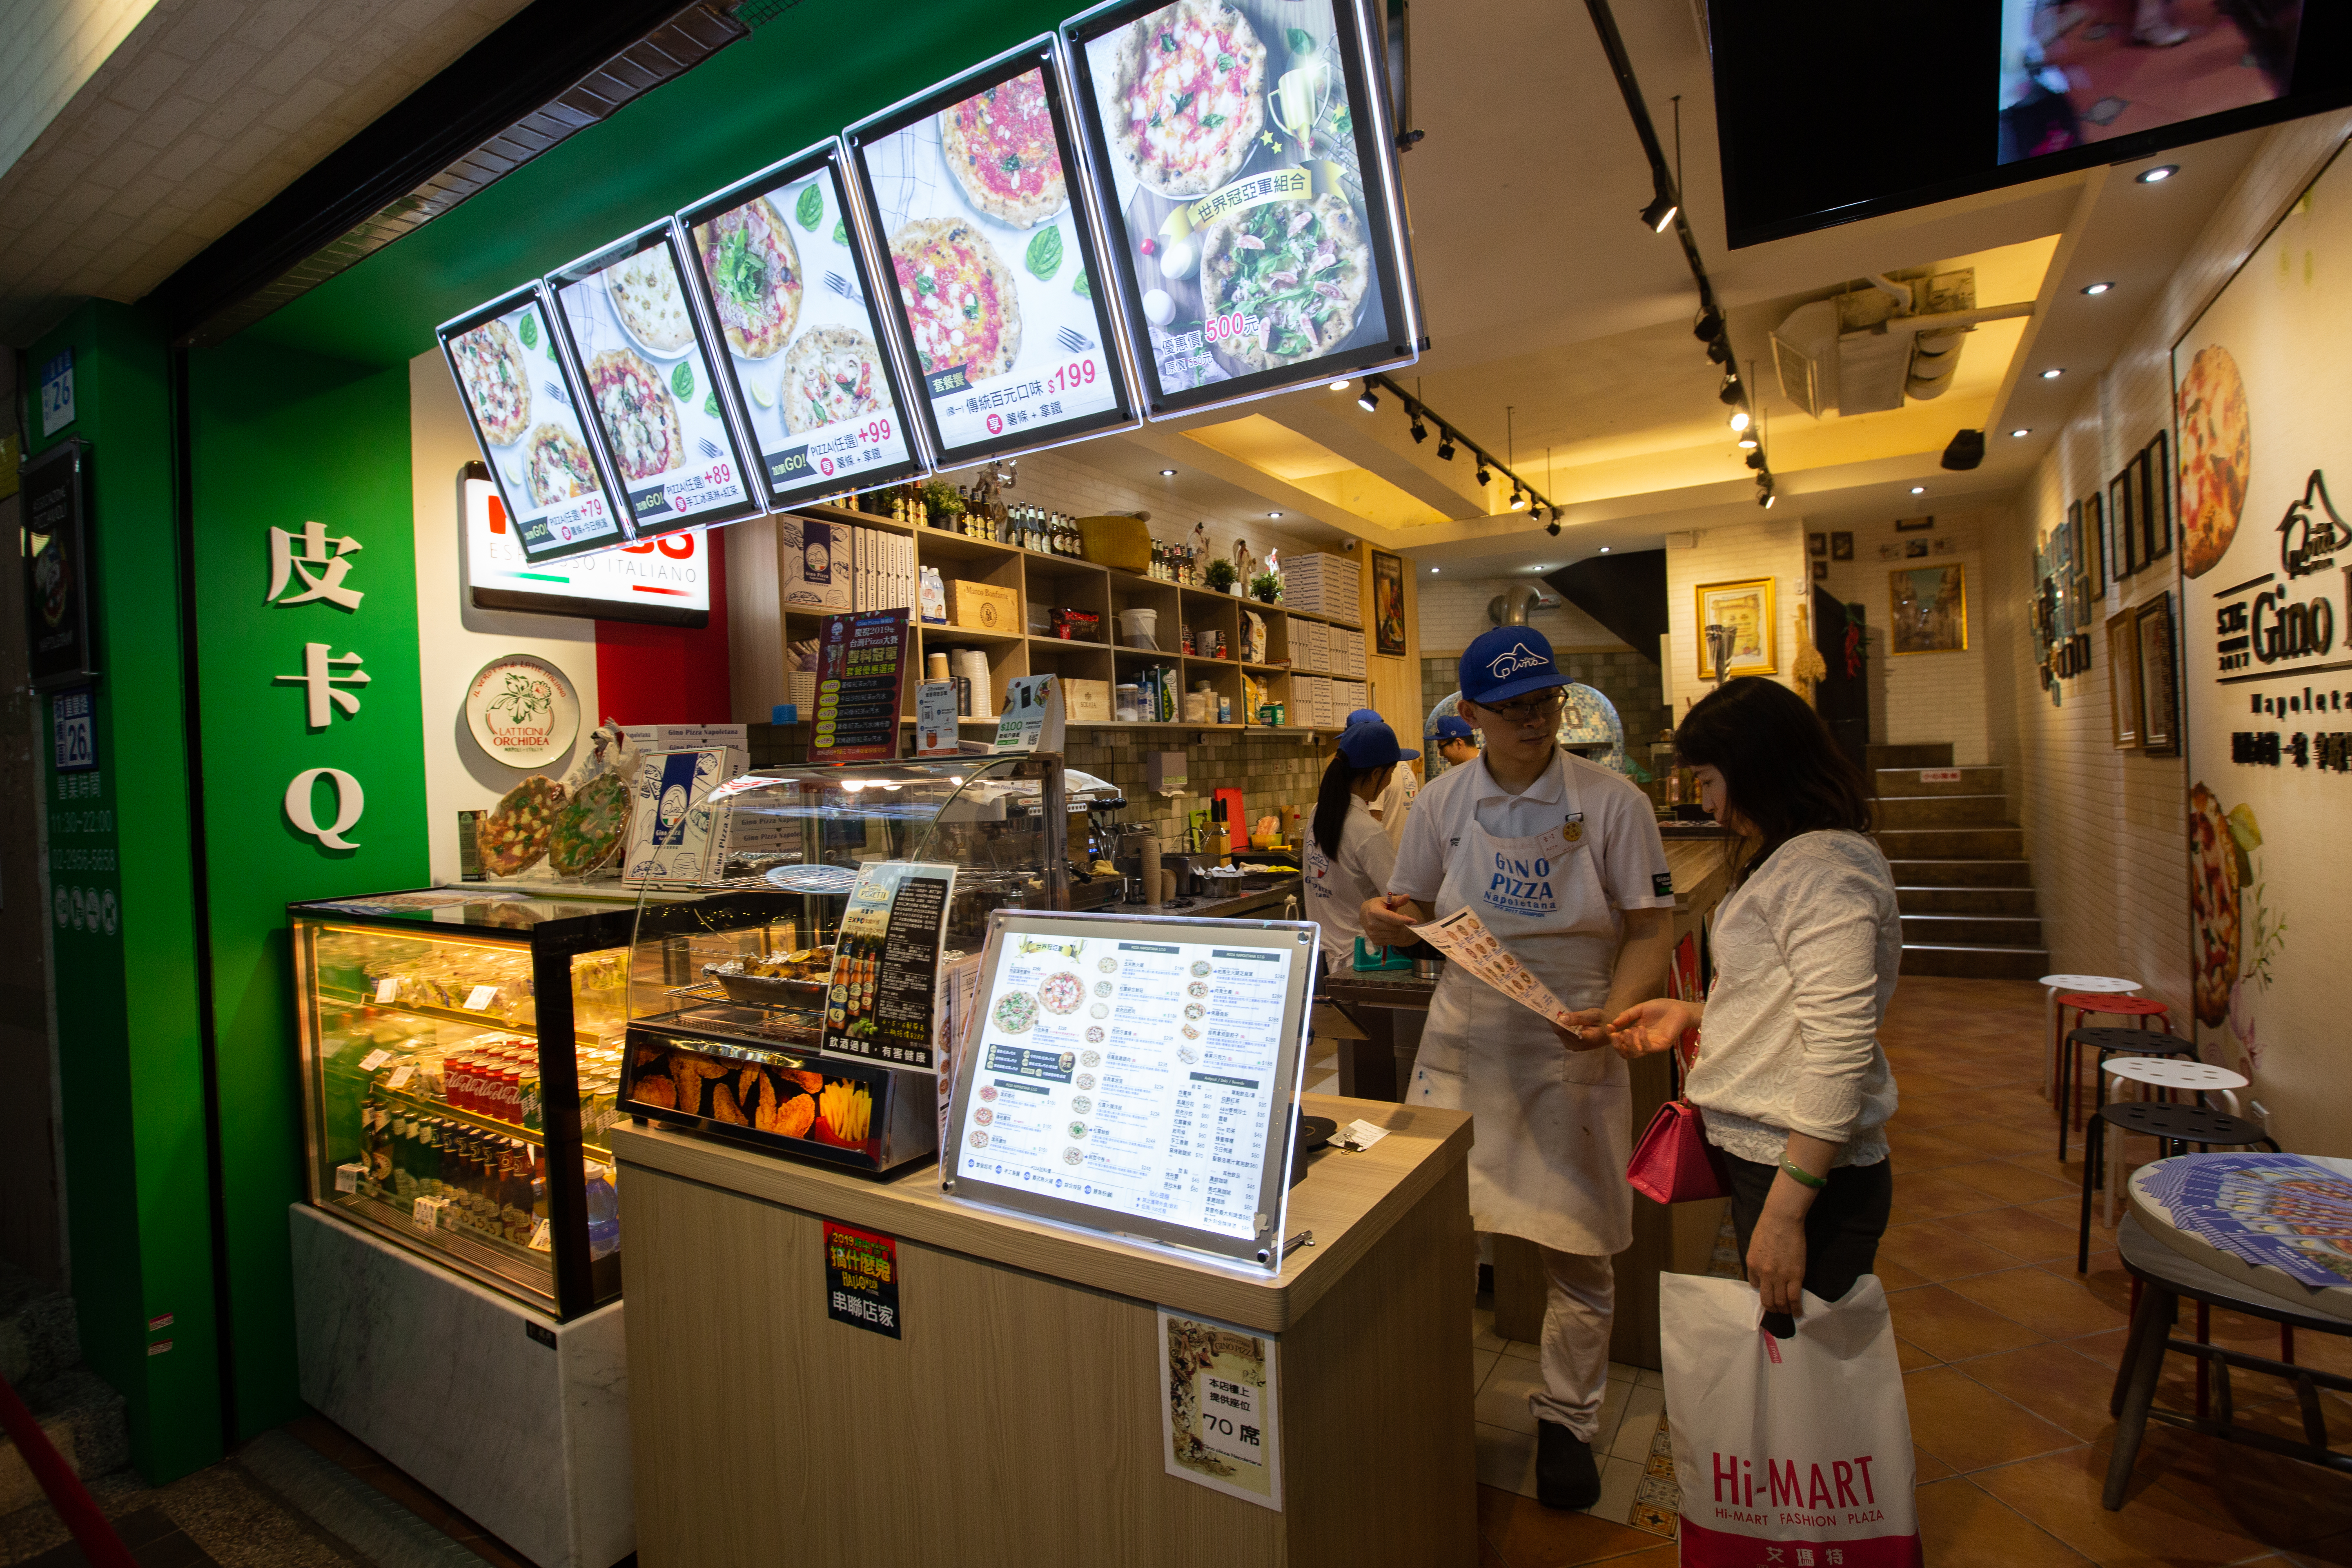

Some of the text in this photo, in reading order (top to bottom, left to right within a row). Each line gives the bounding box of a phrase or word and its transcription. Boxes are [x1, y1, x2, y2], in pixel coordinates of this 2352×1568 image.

[1198, 172, 1305, 223] 世界冠亞軍組合
[1162, 312, 1260, 356] 優惠價 500元
[1166, 358, 1186, 374] 原價
[53, 376, 70, 412] 26
[966, 380, 1044, 414] 傳統百元口味
[1048, 359, 1095, 395] $199
[1006, 410, 1029, 426] 薯條
[1039, 401, 1062, 418] 拿鐵
[811, 419, 891, 457] PIZZA(任選) +99
[836, 455, 853, 469] 薯條
[862, 448, 882, 462] 拿鐵
[704, 464, 730, 484] +89
[581, 499, 602, 517] +79
[608, 558, 696, 583] ITALIANO
[966, 585, 1009, 601] Marco Bonfante
[855, 626, 895, 637] 慶祝2019年
[2251, 584, 2333, 666] Gino
[850, 635, 898, 648] 台灣Pizza大賽
[499, 727, 543, 736] LATTICINI
[1000, 721, 1022, 731] $100
[68, 723, 86, 762] 26
[493, 737, 549, 746] ORCHIDEA
[714, 853, 724, 875] Gino
[719, 822, 728, 849] Pizza
[1495, 852, 1550, 878] GINO
[1490, 872, 1553, 900] PIZZA
[1483, 890, 1557, 909] Napoletana
[833, 1011, 840, 1019] 4
[851, 1001, 856, 1009] 5
[829, 1036, 926, 1063] 飲酒過量，有害健康
[832, 1232, 854, 1246] 2019
[833, 1291, 894, 1327] 串聯店家
[1209, 1378, 1250, 1398] 本店樓上
[1209, 1391, 1251, 1412] 提供座位
[1203, 1413, 1261, 1446] 70 席
[1713, 1452, 1875, 1510] Hi-MART
[1715, 1507, 1884, 1527] Hi-MART FASHION PLAZA
